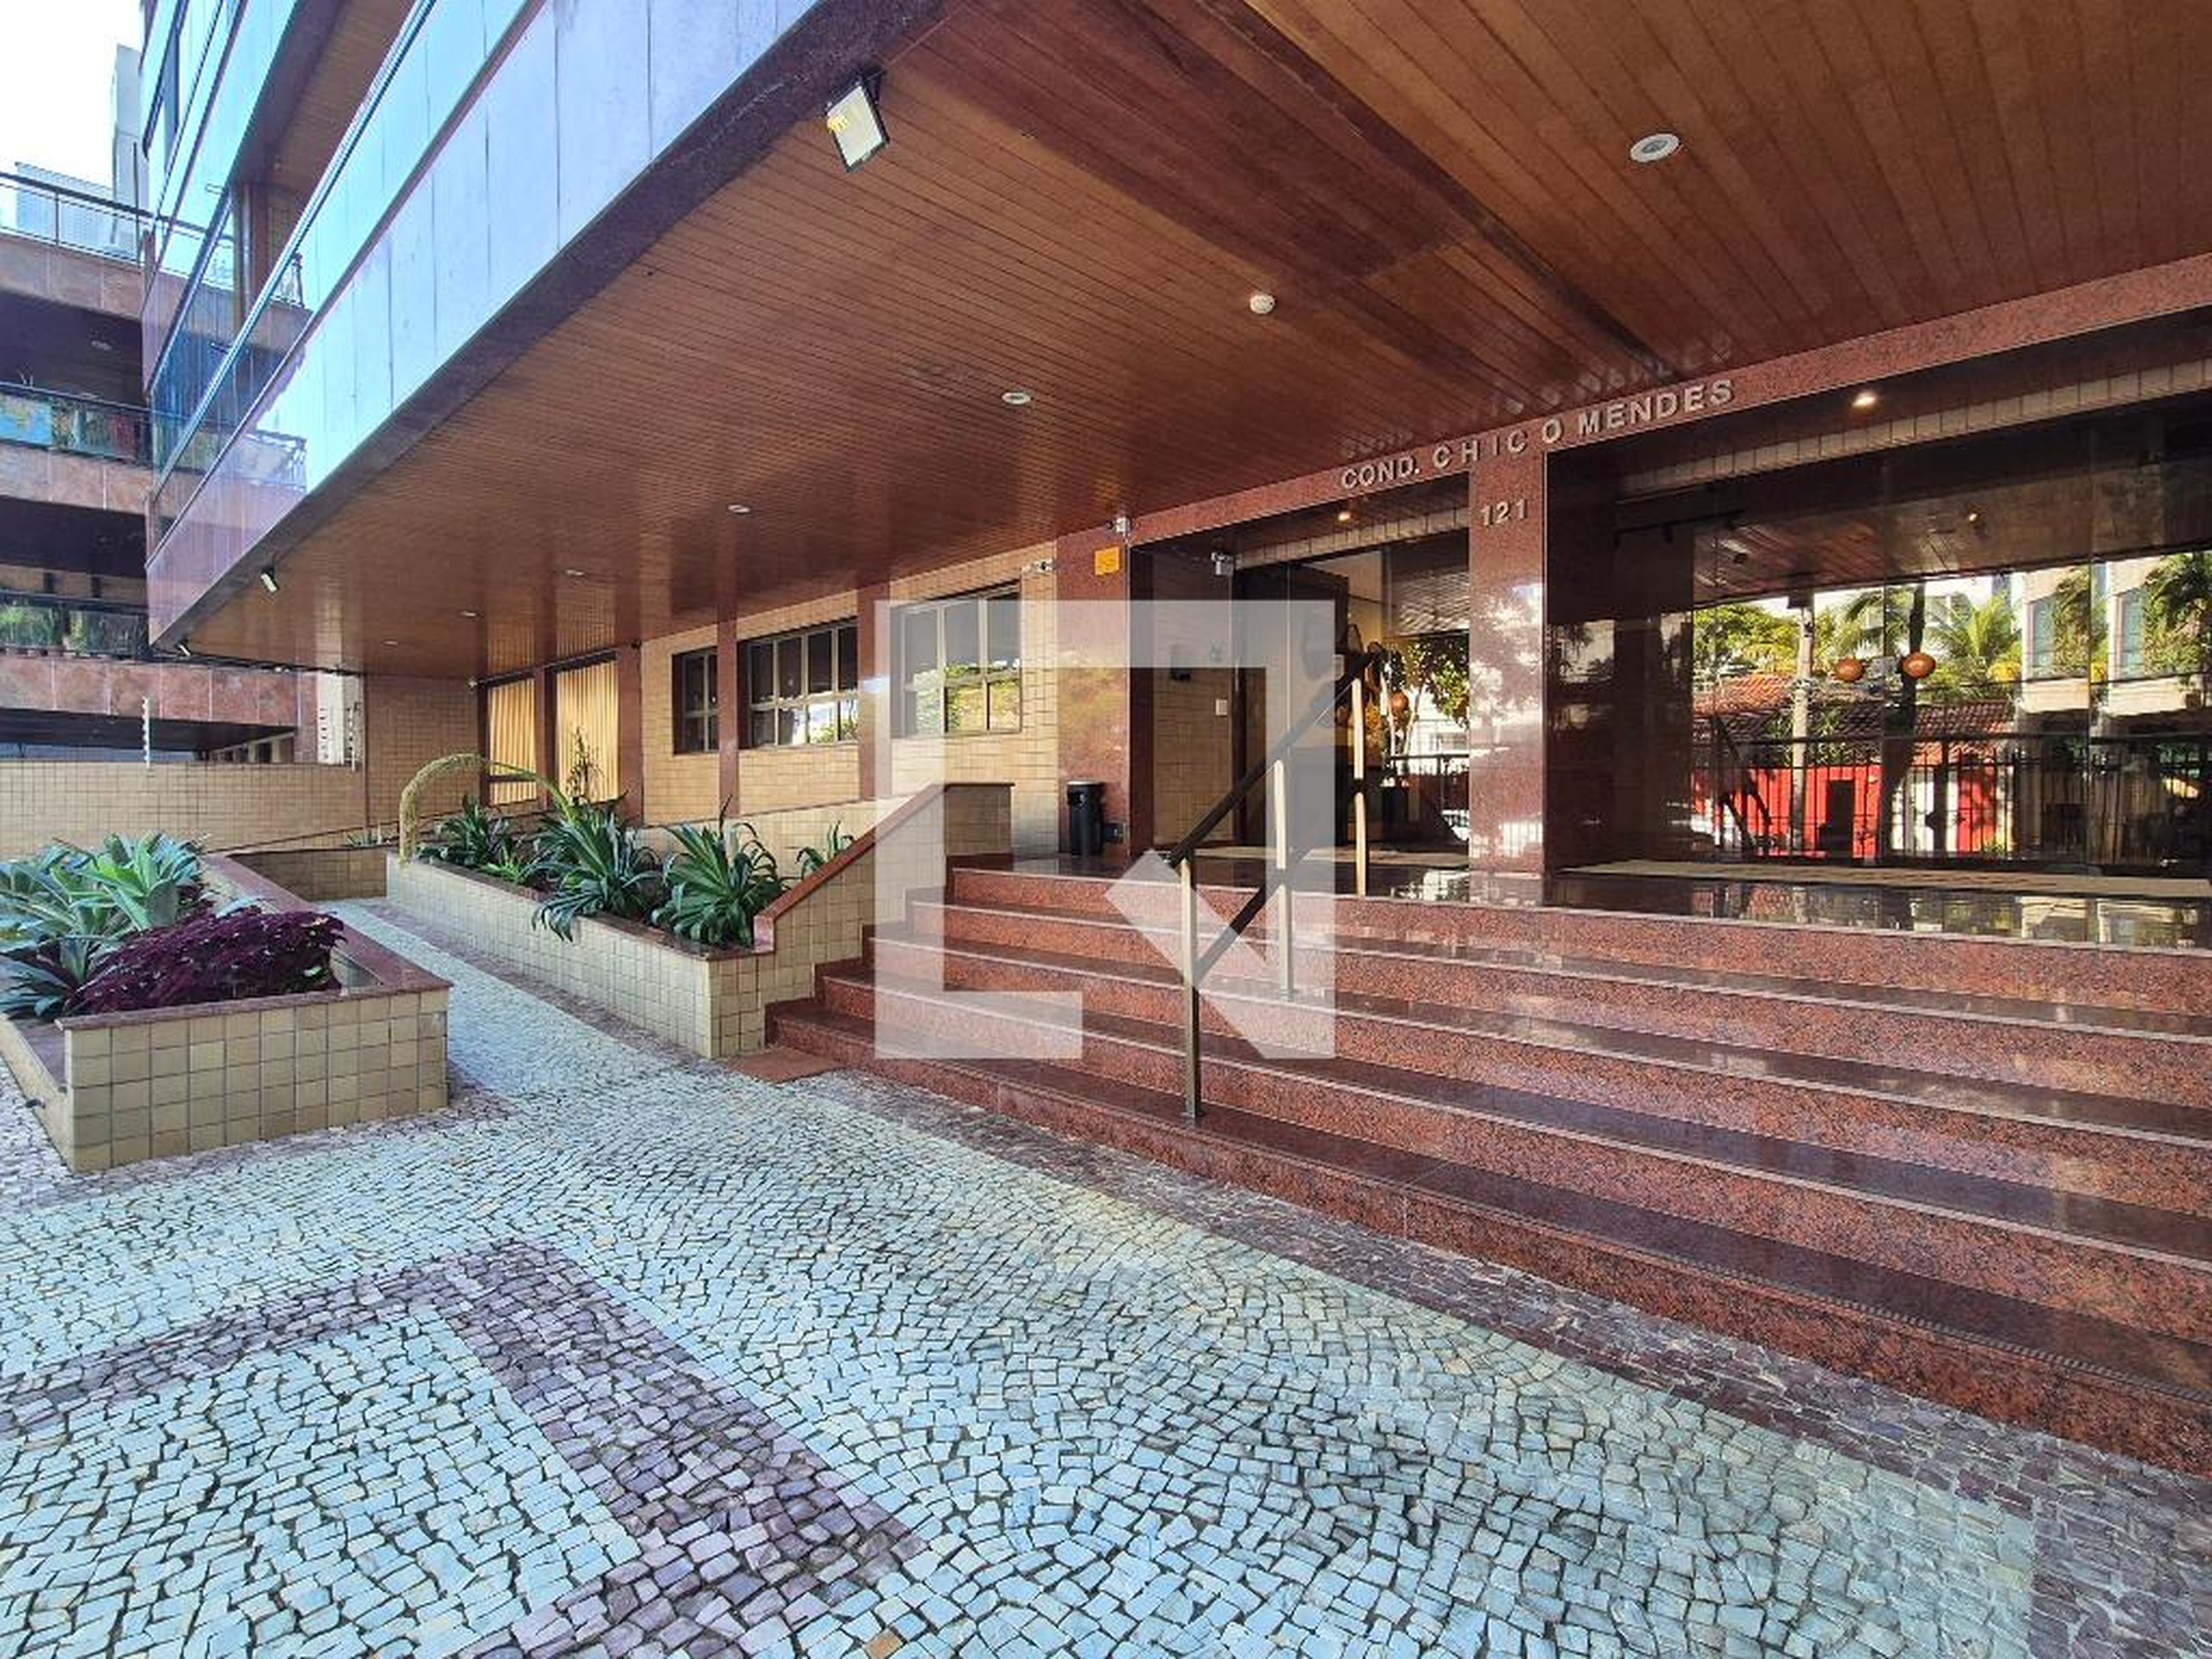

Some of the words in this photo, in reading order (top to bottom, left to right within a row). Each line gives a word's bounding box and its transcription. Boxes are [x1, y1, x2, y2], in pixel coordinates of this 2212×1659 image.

[1341, 456, 1421, 489] COND.
[1431, 419, 1563, 468] CHICO
[1578, 379, 1734, 435] MENDES
[1481, 498, 1528, 527] 121
